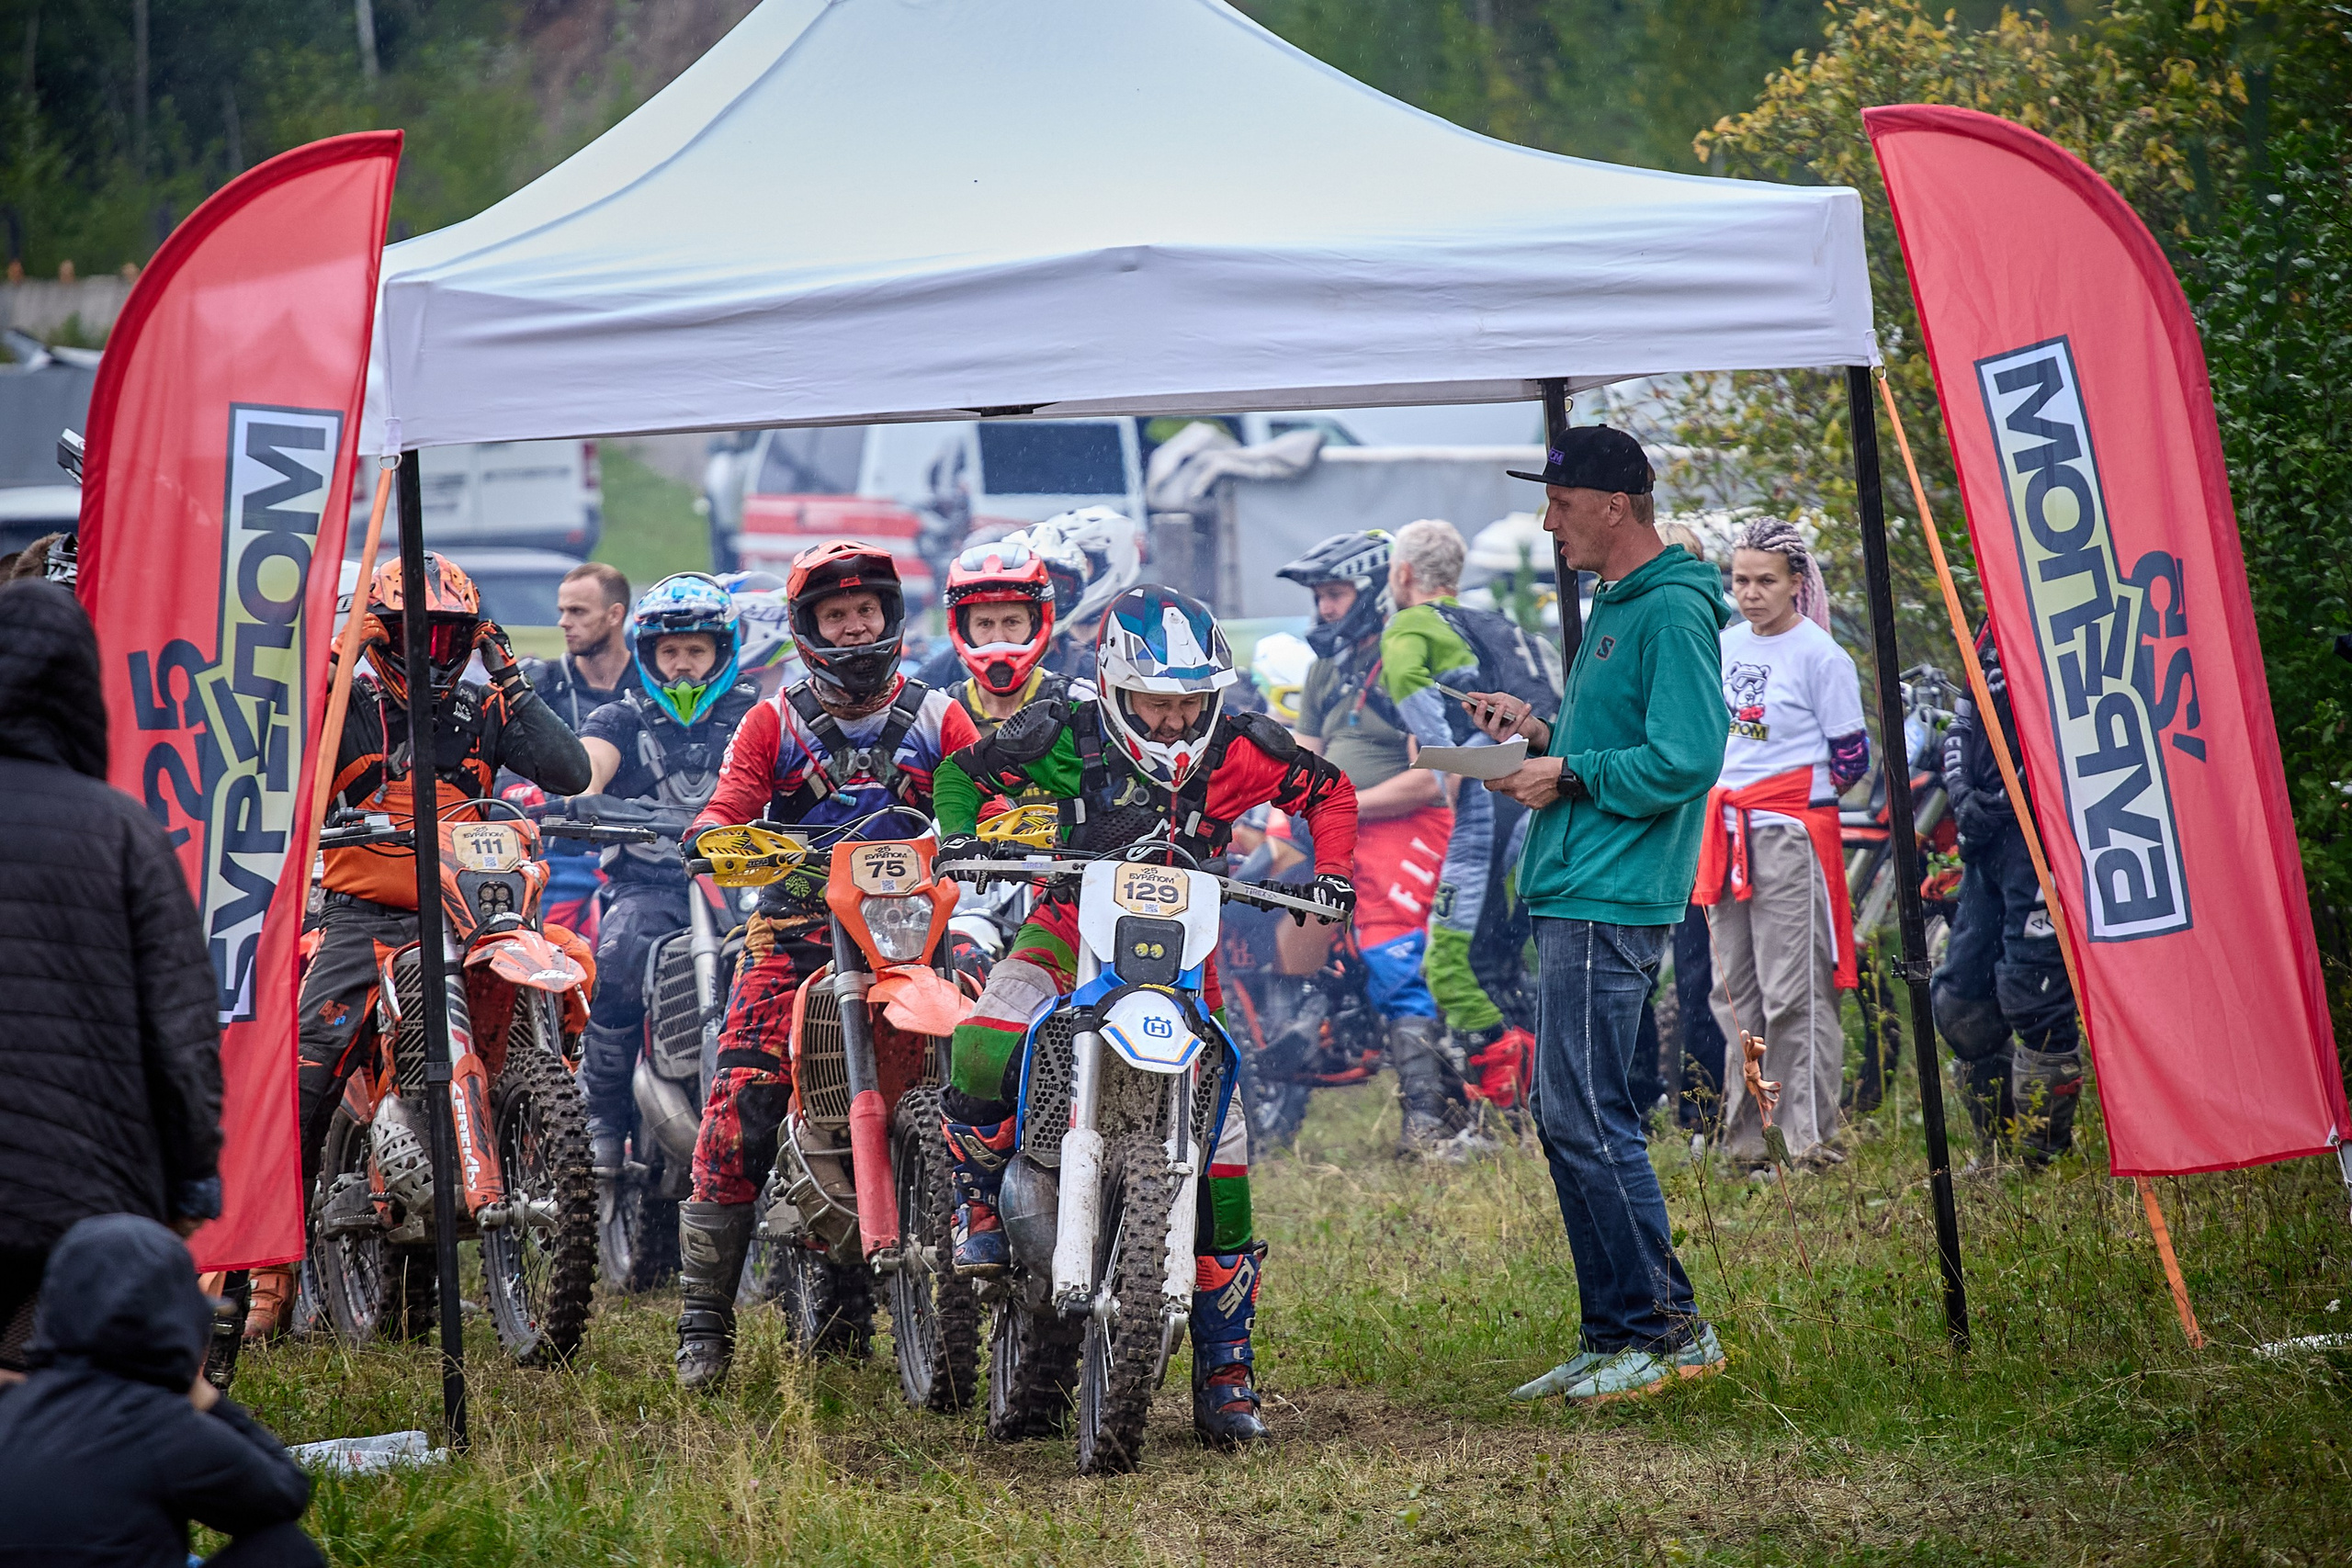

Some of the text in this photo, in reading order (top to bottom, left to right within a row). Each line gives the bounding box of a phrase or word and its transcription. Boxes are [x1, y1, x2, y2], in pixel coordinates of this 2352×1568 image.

[470, 838, 503, 854] 111
[865, 860, 906, 878] 75
[1123, 881, 1180, 904] 129
